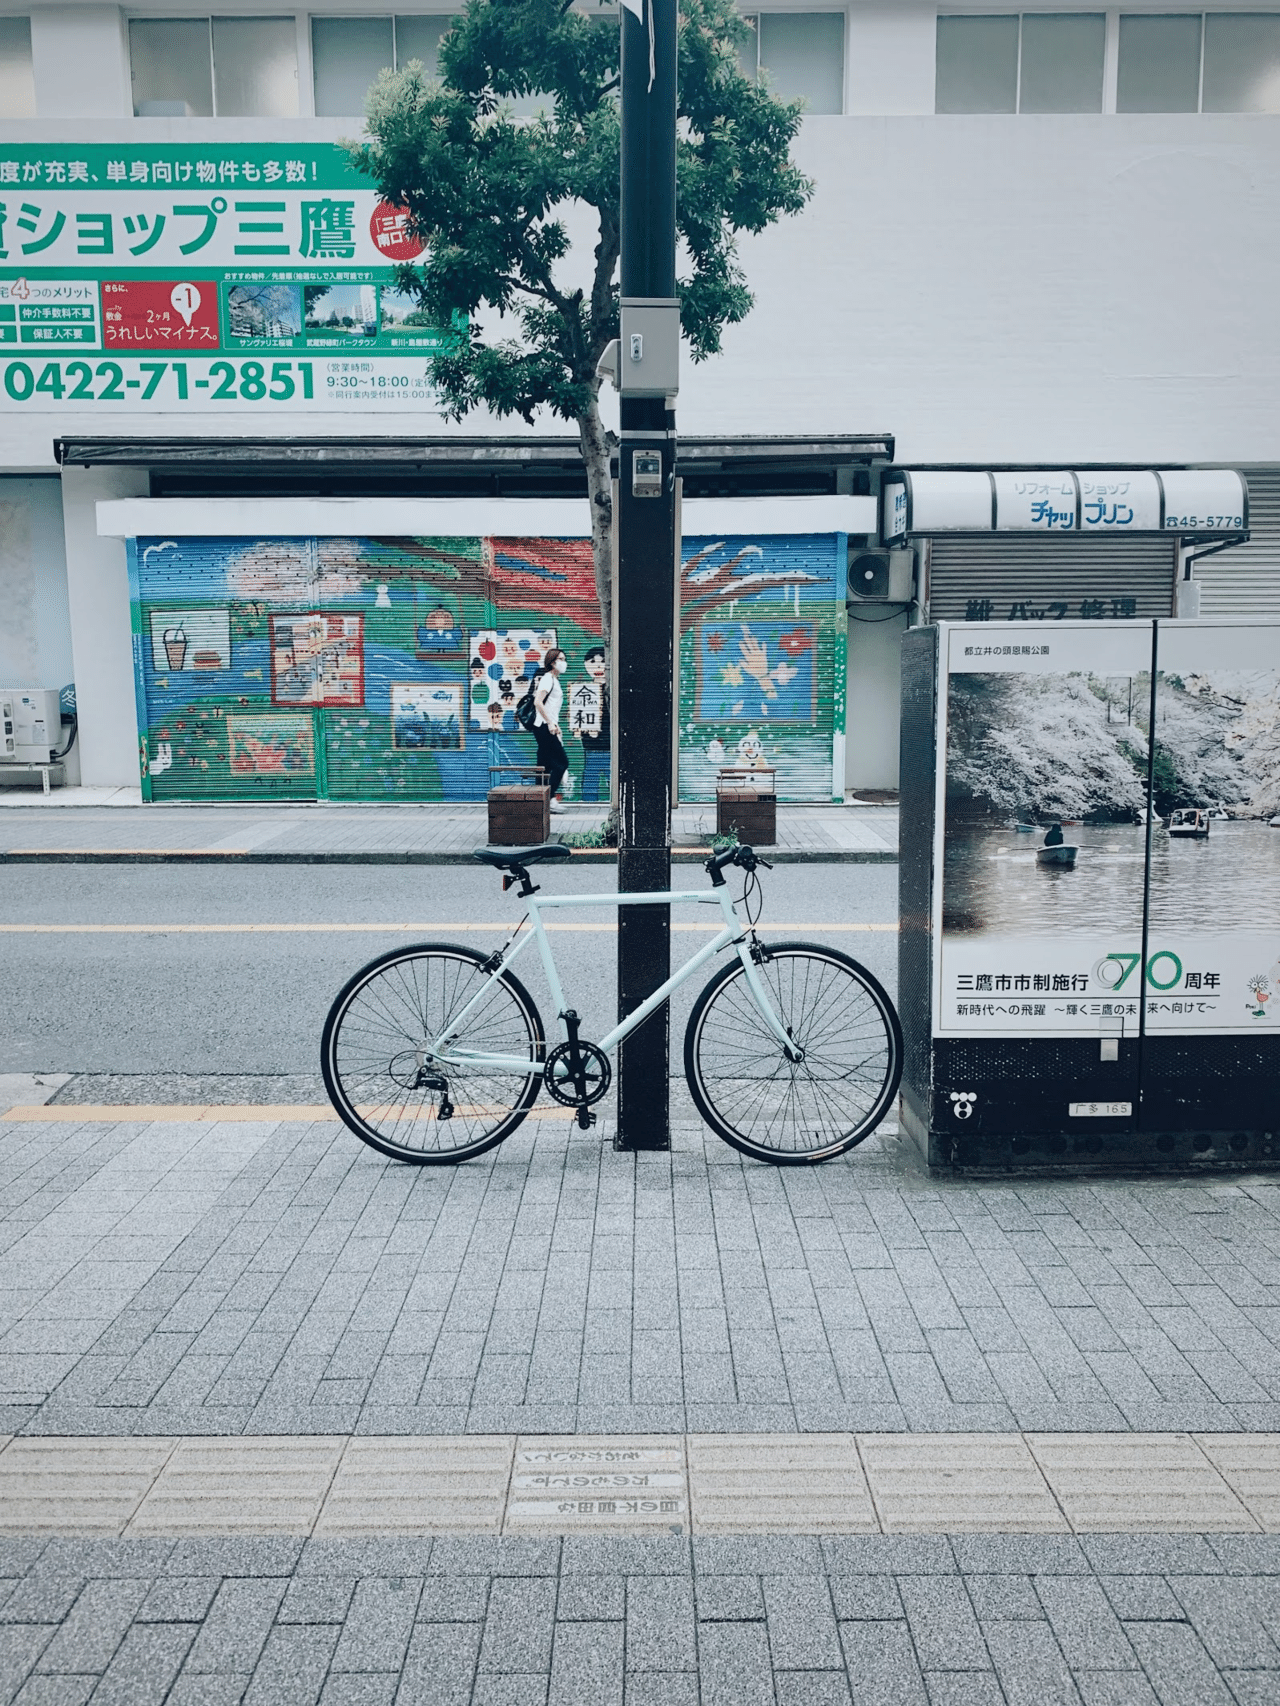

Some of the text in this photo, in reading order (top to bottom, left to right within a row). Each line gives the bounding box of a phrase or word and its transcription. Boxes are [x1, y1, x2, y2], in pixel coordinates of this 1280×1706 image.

[0, 196, 356, 259] ショップ三鷹
[175, 288, 192, 308] -1
[22, 307, 91, 319] 仲介手数料不要
[33, 328, 83, 340] 保証人不要
[106, 325, 218, 341] うれしいマイナス。
[4, 361, 314, 401] 0422-71-2851
[1015, 482, 1131, 495] リフォーム ショップ
[964, 646, 1050, 656] 都立井の頭恩賜公園
[956, 1004, 1046, 1016] 新時代への飛躍
[557, 1501, 679, 1514] 目の不自由な
